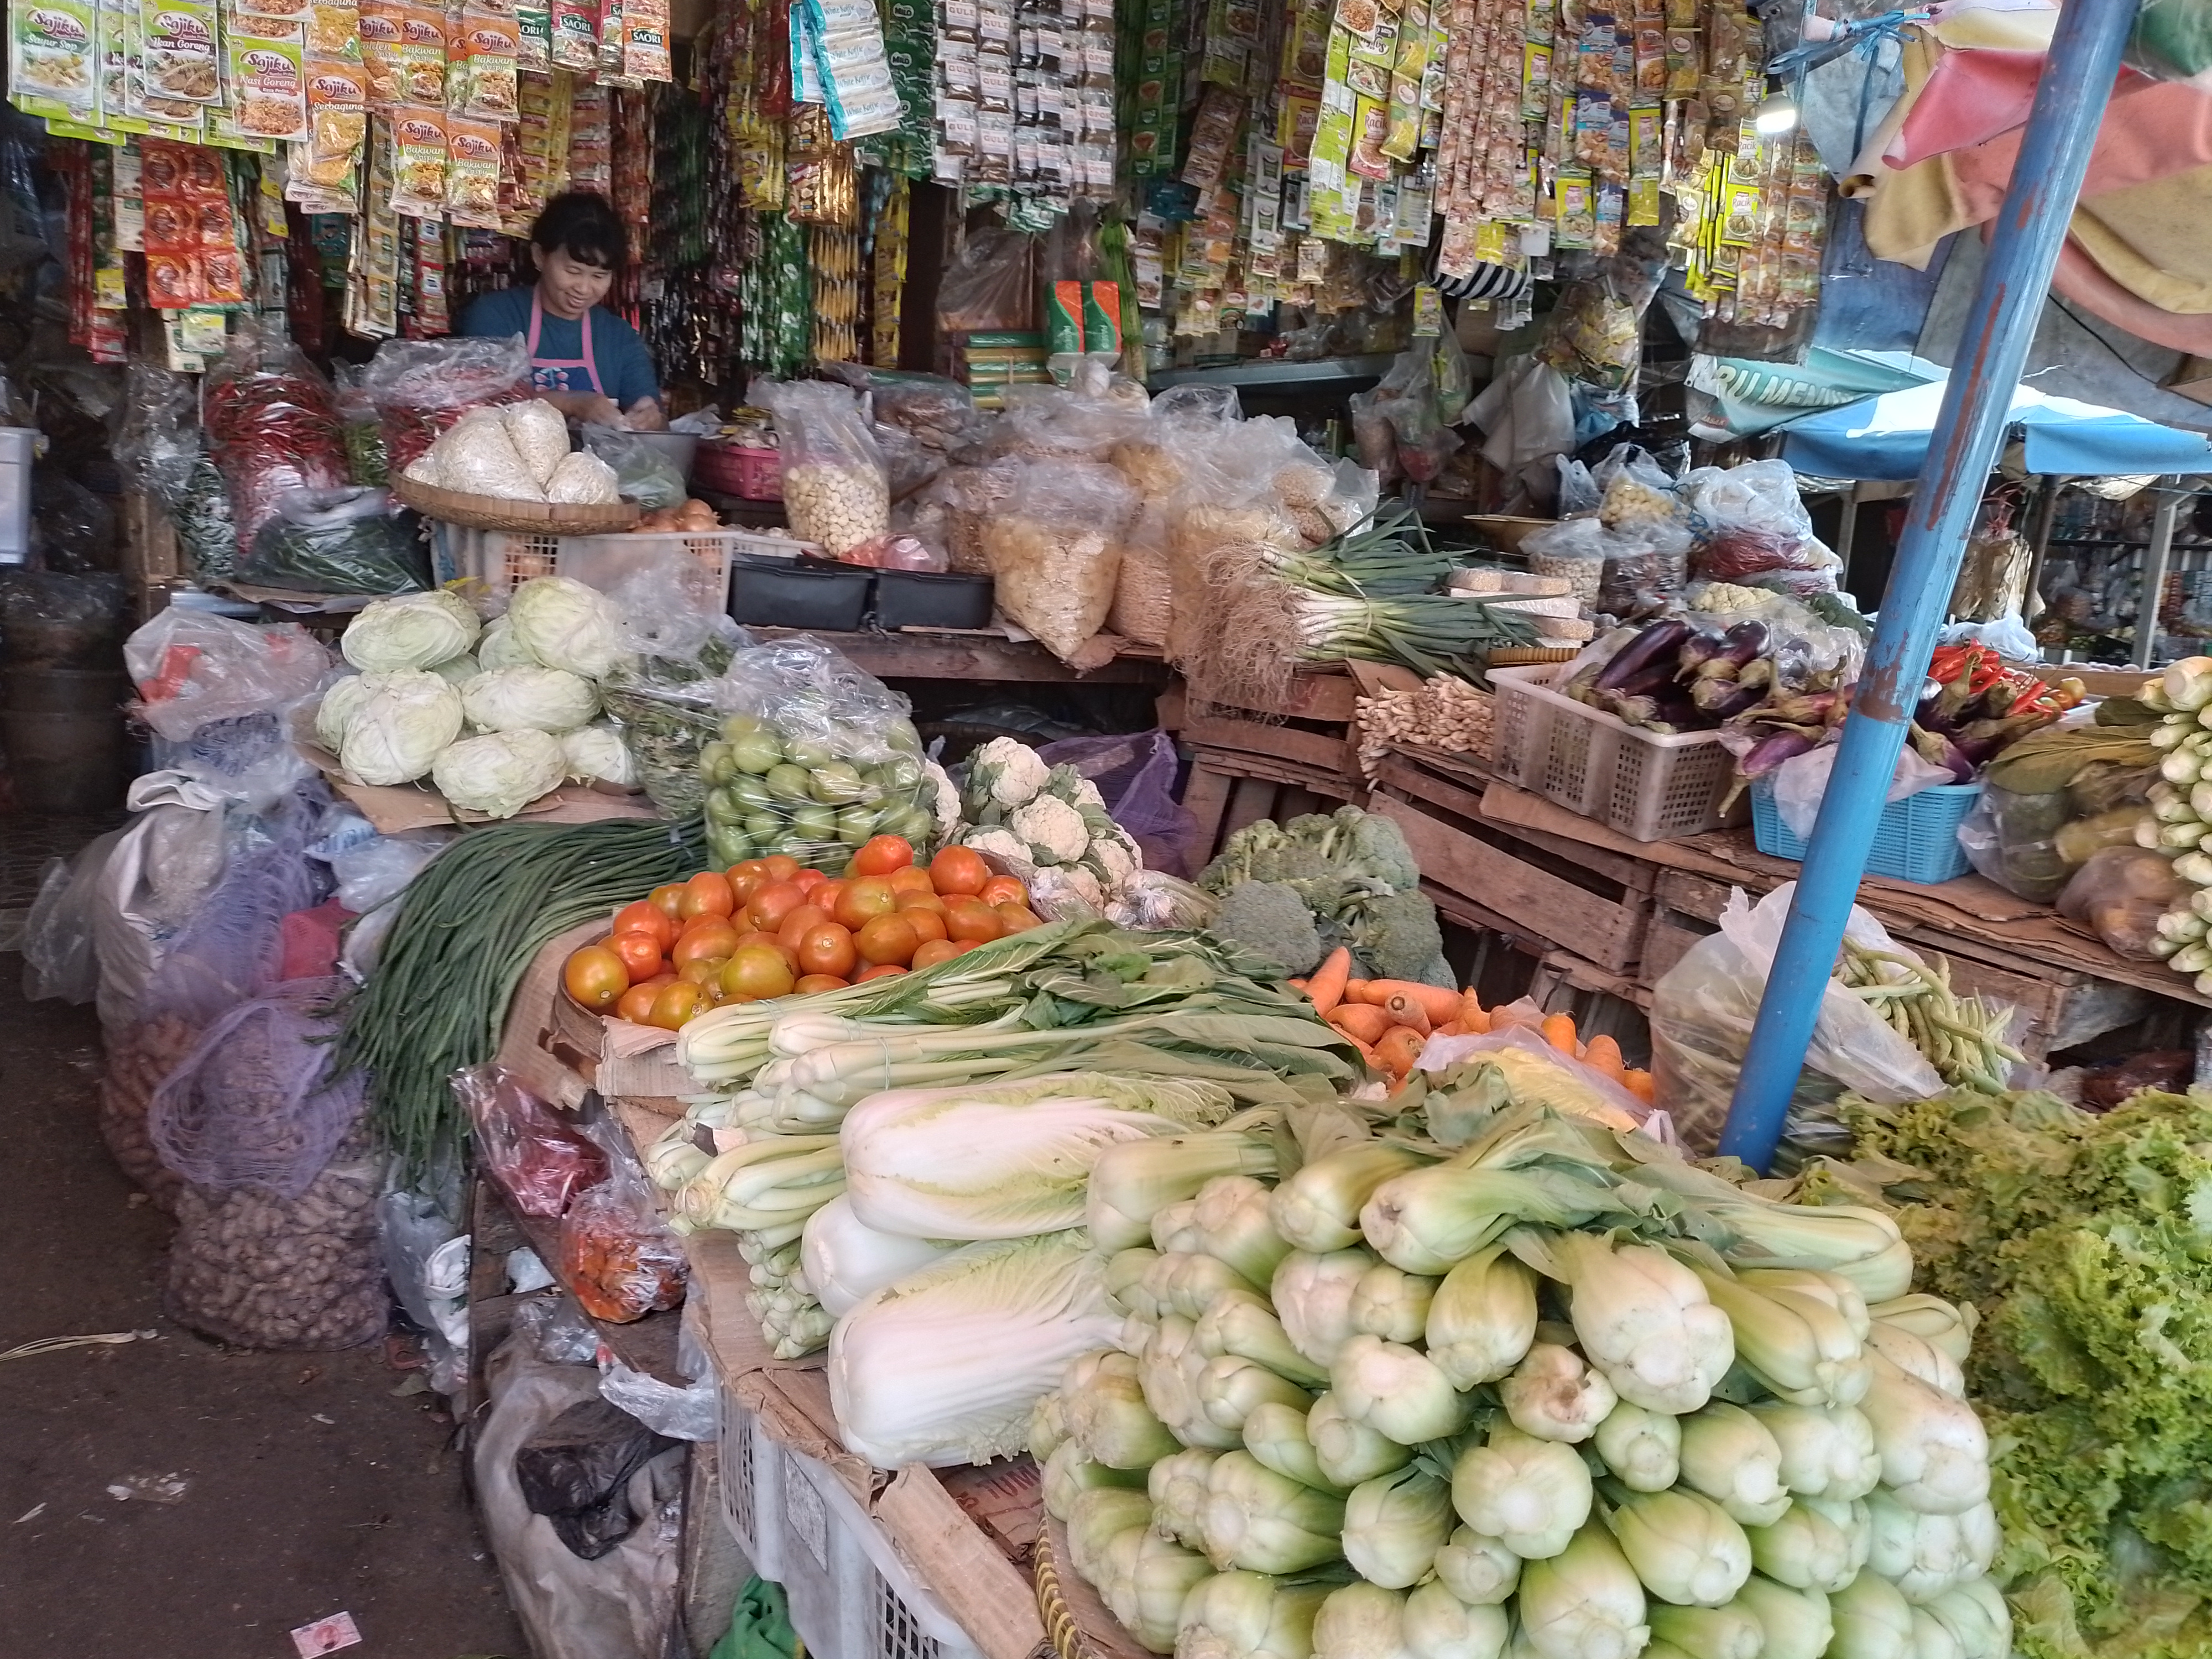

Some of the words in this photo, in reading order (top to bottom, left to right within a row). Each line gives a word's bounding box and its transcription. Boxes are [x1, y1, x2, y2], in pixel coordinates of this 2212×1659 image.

[895, 7, 912, 16] MILO
[34, 12, 79, 34] Sajiku
[160, 15, 204, 36] Sajiku
[359, 18, 394, 38] Sajiku
[519, 25, 540, 35] AORI
[563, 18, 591, 33] SAORI
[403, 22, 439, 41] Sajiku
[633, 32, 661, 44] SAORI
[28, 34, 58, 47] Sayur
[59, 39, 78, 53] Sop
[177, 38, 210, 54] Goreng
[474, 32, 512, 51] Sajiku
[402, 44, 441, 55] Bakwan
[248, 53, 290, 74] Sajiku
[473, 54, 513, 65] Bakwan
[892, 56, 910, 64] MILO
[239, 75, 260, 85] Nasi
[263, 77, 296, 88] Goreng
[316, 79, 357, 98] Sajiku
[314, 101, 364, 112] Serbaguna
[1365, 115, 1387, 130] Racik
[405, 122, 442, 141] Sajiku
[405, 144, 444, 155] Bakwan
[457, 137, 493, 156] Sajiku
[1738, 141, 1757, 150] Racik
[456, 158, 494, 169] Bakwan
[1733, 197, 1752, 207] Racik
[975, 1462, 1041, 1500] TUM
